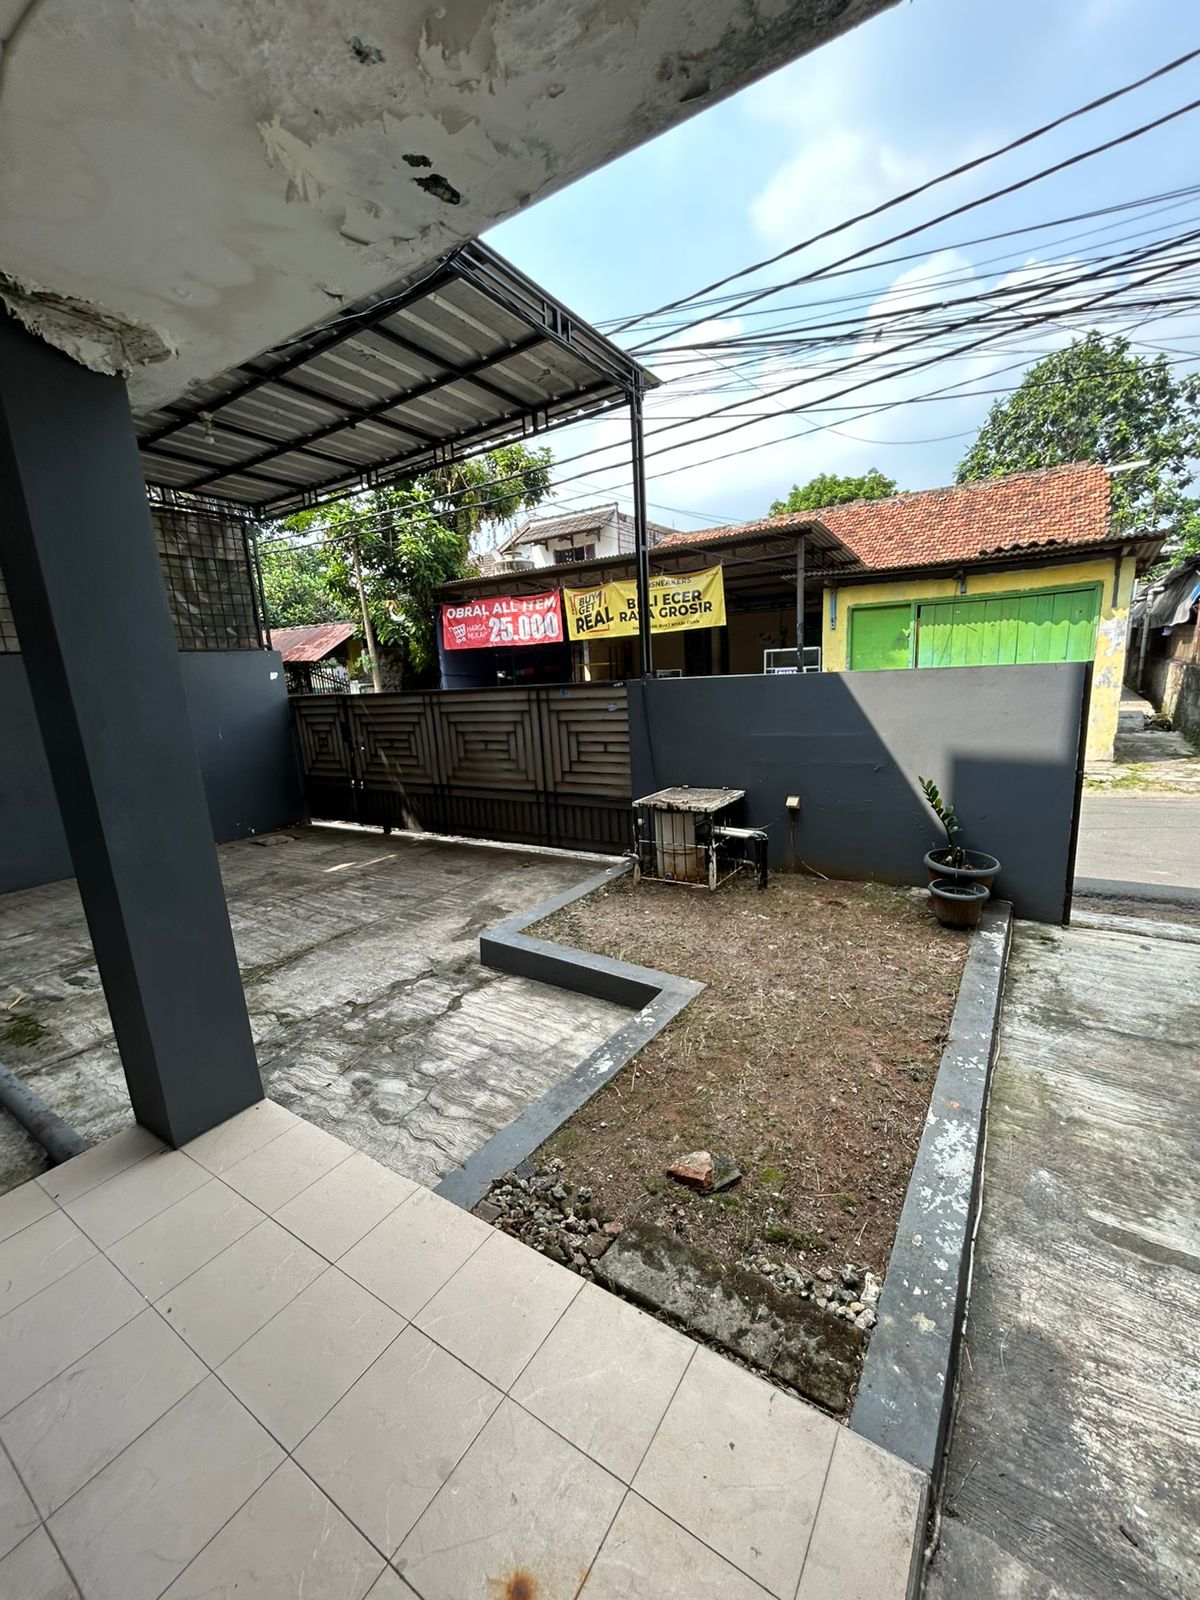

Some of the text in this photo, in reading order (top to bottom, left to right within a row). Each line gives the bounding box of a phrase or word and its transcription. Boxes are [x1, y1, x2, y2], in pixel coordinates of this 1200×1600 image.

[579, 592, 597, 606] BUY
[662, 590, 702, 605] ECER
[446, 604, 489, 619] OBRAL
[492, 601, 518, 614] ALL
[578, 602, 595, 615] GET
[619, 601, 712, 622] RAA GROSIR
[488, 612, 559, 643] 25.000
[575, 606, 614, 634] REAL
